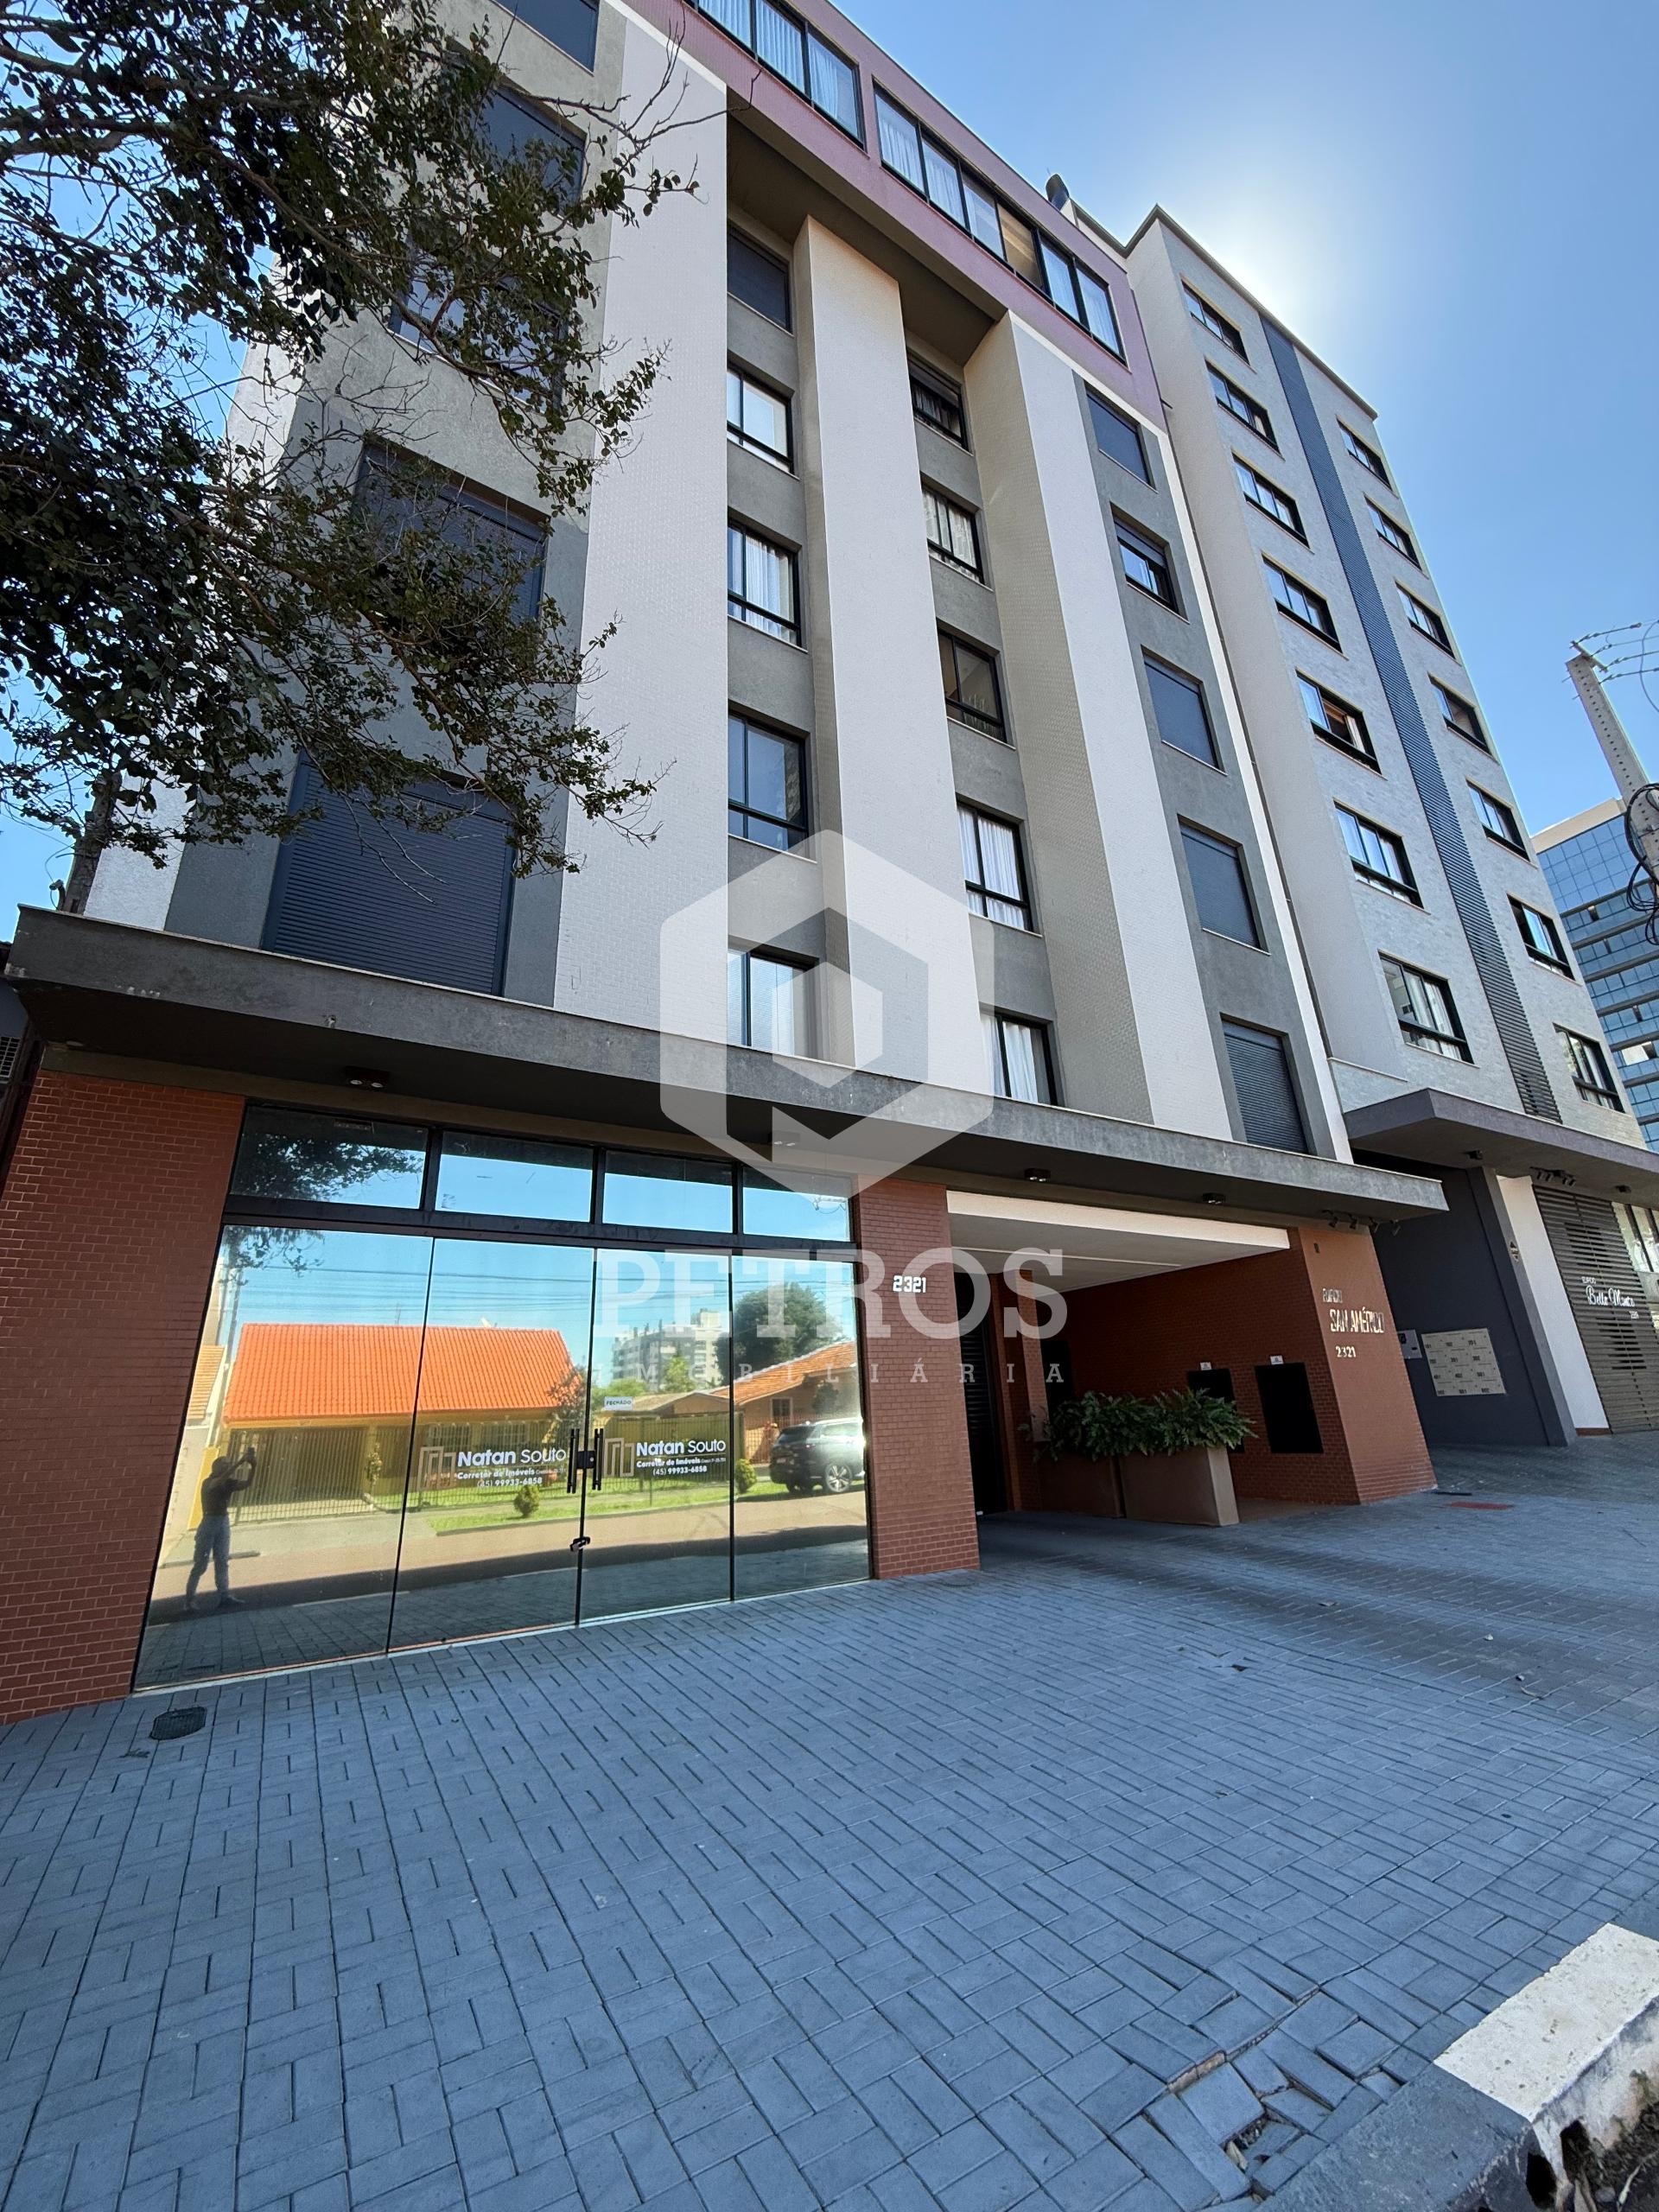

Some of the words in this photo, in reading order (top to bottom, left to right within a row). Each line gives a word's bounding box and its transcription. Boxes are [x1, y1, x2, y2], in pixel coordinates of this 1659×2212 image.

[893, 1275, 927, 1294] 2321
[1335, 1345, 1357, 1357] 2321
[636, 1440, 684, 1457] Natan
[687, 1439, 726, 1452] Souto
[457, 1449, 516, 1467] Natan
[520, 1447, 567, 1463] Souto
[636, 1458, 665, 1468] Corretor
[676, 1457, 700, 1465] Imóveis
[457, 1470, 492, 1479] Corretor
[505, 1468, 535, 1477] Imóveis
